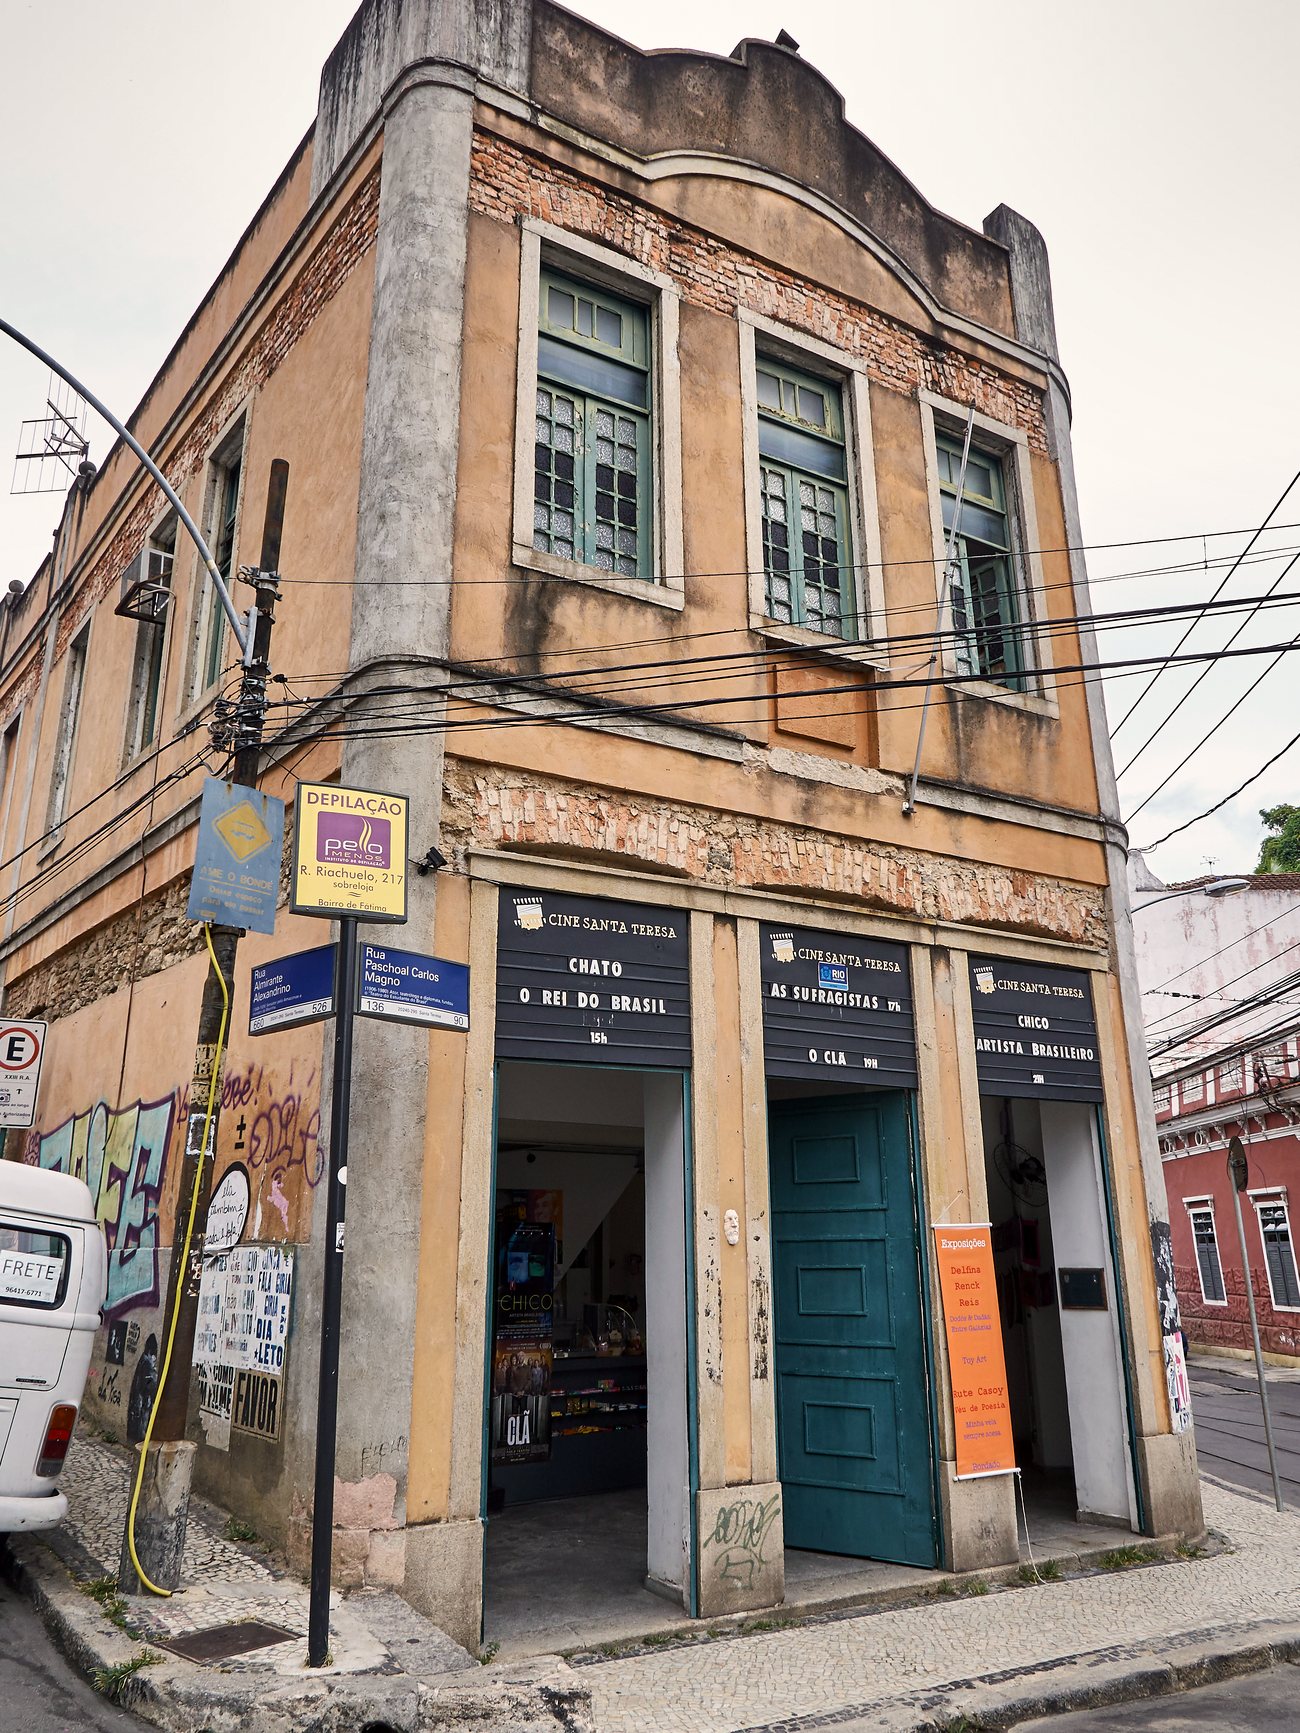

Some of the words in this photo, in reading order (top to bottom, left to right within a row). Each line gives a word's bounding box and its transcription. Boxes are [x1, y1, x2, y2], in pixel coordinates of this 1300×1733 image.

[307, 791, 402, 816] DEPILAÇÃO
[325, 816, 382, 856] pelo
[332, 850, 382, 862] MENOS
[228, 872, 236, 881] O
[240, 875, 273, 890] BONDE
[300, 865, 311, 876] R.
[316, 866, 378, 883] Riachuelo,
[382, 873, 403, 885] 217
[333, 880, 374, 892] sobreloja
[318, 899, 344, 908] Bairro
[360, 902, 387, 912] Fátima
[548, 914, 580, 927] CINE
[582, 918, 628, 933] SANTA
[631, 924, 677, 938] TERESA
[366, 947, 385, 959] Rua
[798, 949, 824, 961] CINE
[826, 952, 862, 967] SANTA
[864, 958, 901, 972] TERESA
[254, 970, 266, 980] Rua
[365, 959, 409, 976] Paschoal
[411, 967, 439, 982] Carlos
[365, 971, 400, 986] Magno
[832, 969, 845, 978] RIO
[254, 975, 283, 991] Almirante
[997, 980, 1019, 991] CINE
[1020, 983, 1051, 995] SANTA
[1052, 987, 1084, 999] TERESA
[253, 984, 290, 1003] Alexandrino
[520, 988, 530, 1003] O
[542, 989, 567, 1006] REI
[578, 992, 599, 1008] DO
[612, 995, 666, 1014] BRASIL
[771, 983, 787, 998] AS
[793, 986, 878, 1009] SUFRAGISTAS
[888, 1001, 900, 1012] 17h
[253, 1018, 264, 1029] 660
[312, 1002, 327, 1013] 526
[367, 1000, 384, 1012] 136
[454, 1016, 464, 1026] 90
[1018, 1015, 1049, 1030] CHICO
[590, 1032, 607, 1044] 15h
[6, 1036, 25, 1061] E
[977, 1038, 1024, 1054] ARTISTA
[1032, 1042, 1093, 1060] BRASILEIRO
[809, 1049, 817, 1062] O
[824, 1051, 846, 1066] CLÃ
[864, 1057, 878, 1069] 19H
[941, 1238, 986, 1249] Exposições
[3, 1259, 55, 1280] FRETE
[951, 1266, 981, 1275] Delfina
[258, 1271, 272, 1293] FALA
[955, 1281, 981, 1291] Renck
[6, 1287, 42, 1296] 96417-6771
[500, 1294, 552, 1311] CHICO
[959, 1298, 980, 1306] Reis
[256, 1318, 272, 1340] DIA
[258, 1342, 283, 1367] LETO
[962, 1356, 975, 1365] Toy
[953, 1390, 975, 1399] Rute
[978, 1386, 1004, 1398] Casoy
[235, 1372, 277, 1434] FAVOR
[969, 1404, 978, 1412] de
[982, 1402, 1006, 1411] Poesia
[507, 1410, 530, 1446] CLÃ
[972, 1461, 1000, 1471] Bordado
